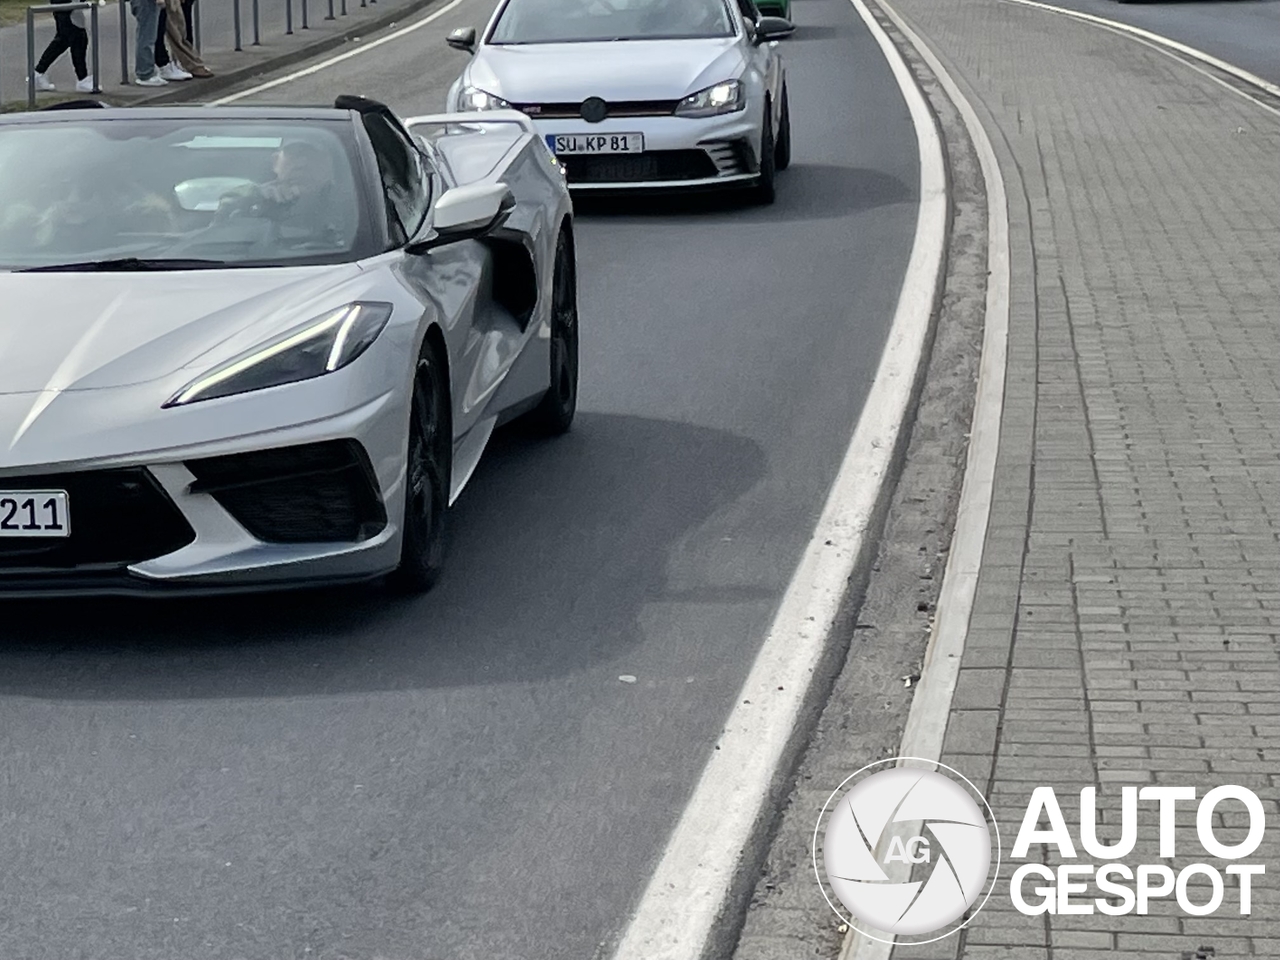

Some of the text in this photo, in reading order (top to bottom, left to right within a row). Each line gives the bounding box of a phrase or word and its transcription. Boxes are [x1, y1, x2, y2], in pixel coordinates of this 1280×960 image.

[556, 136, 629, 152] SU KP 81
